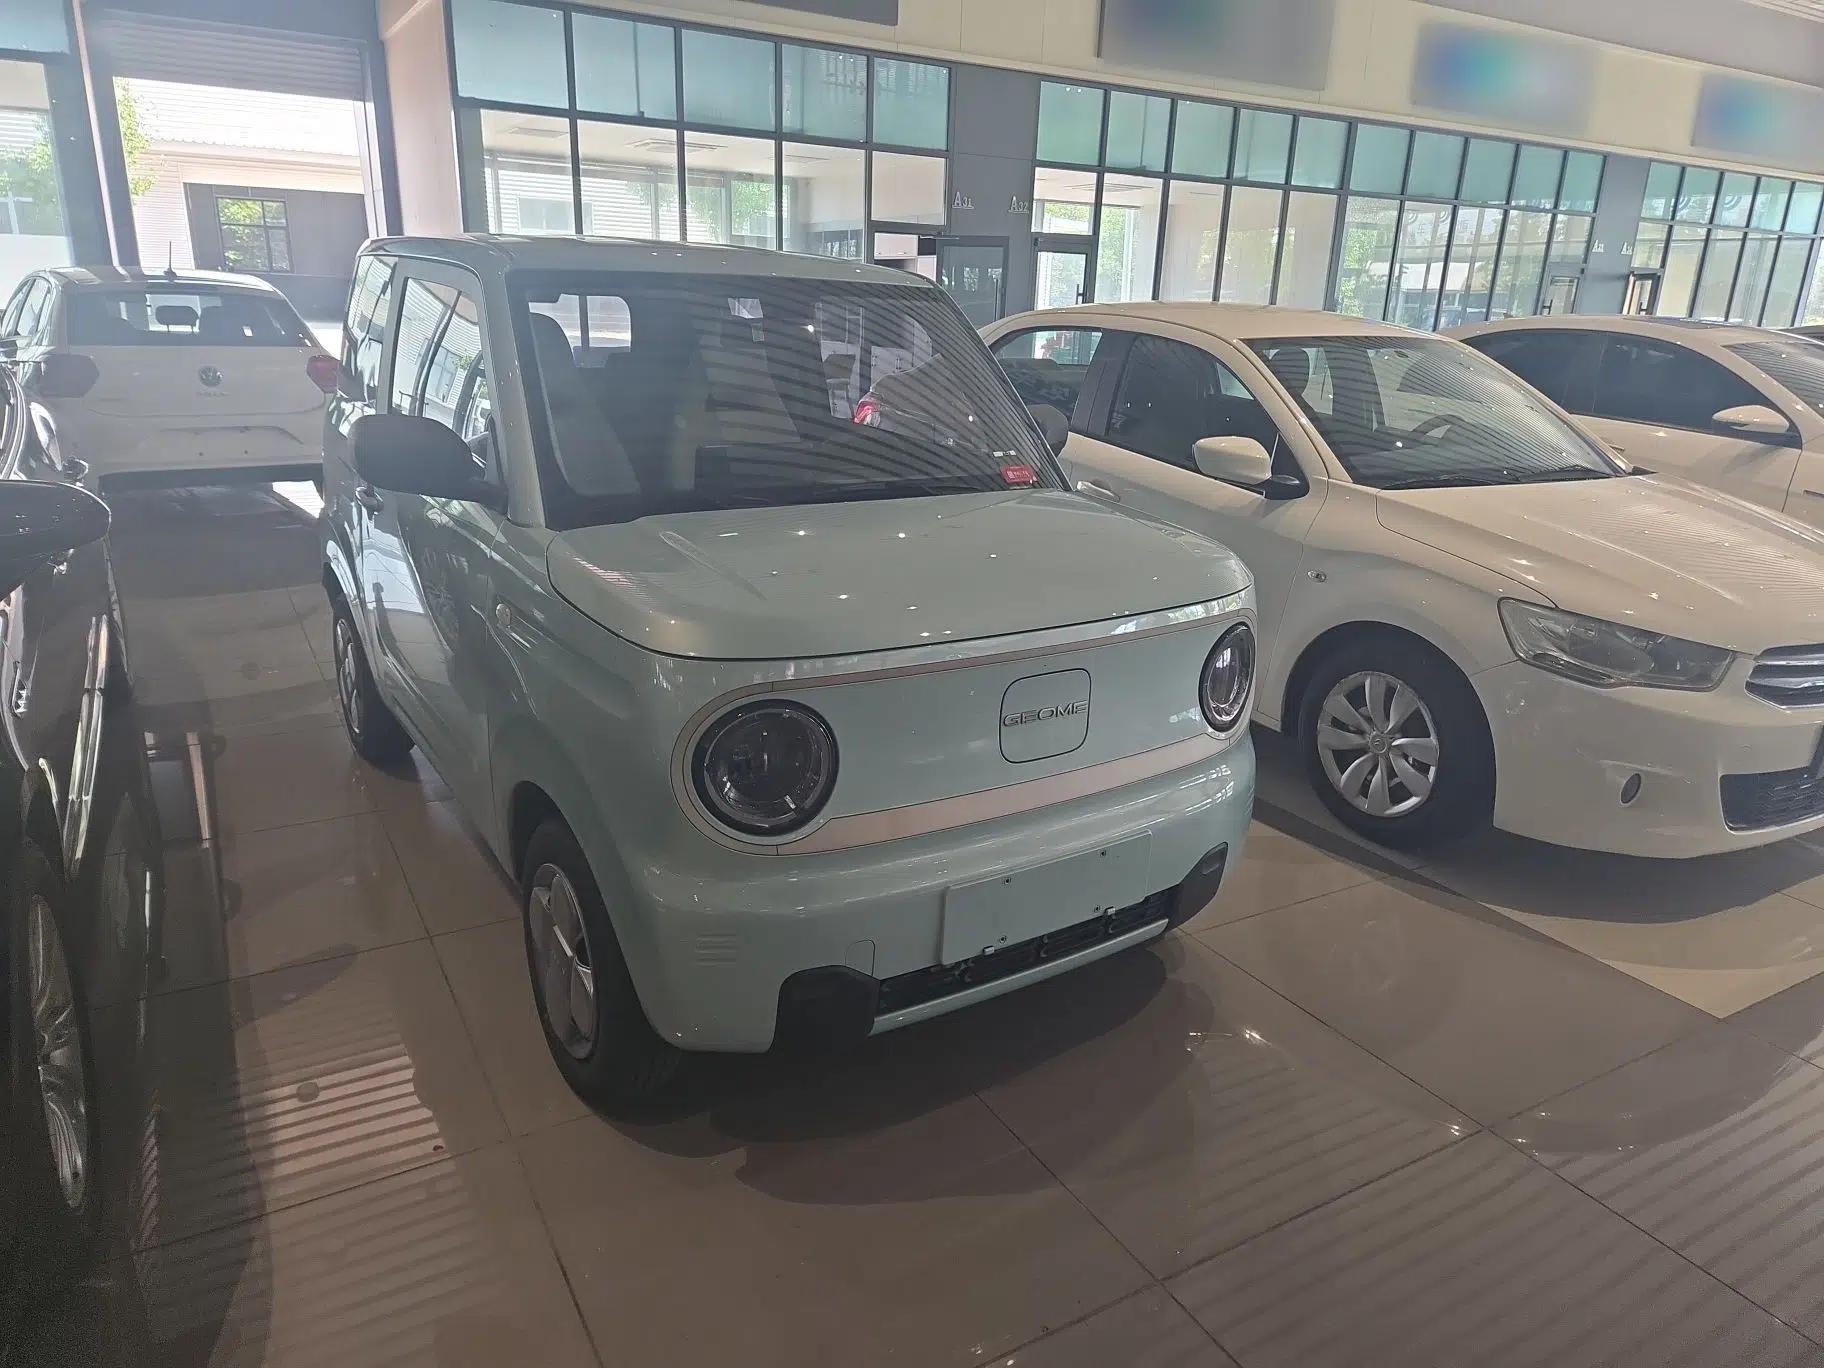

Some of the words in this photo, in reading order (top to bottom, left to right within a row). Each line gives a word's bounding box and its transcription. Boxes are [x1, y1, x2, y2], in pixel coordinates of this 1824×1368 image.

[953, 191, 974, 209] A31
[1009, 195, 1029, 213] A32
[1003, 699, 1088, 727] GEOME
